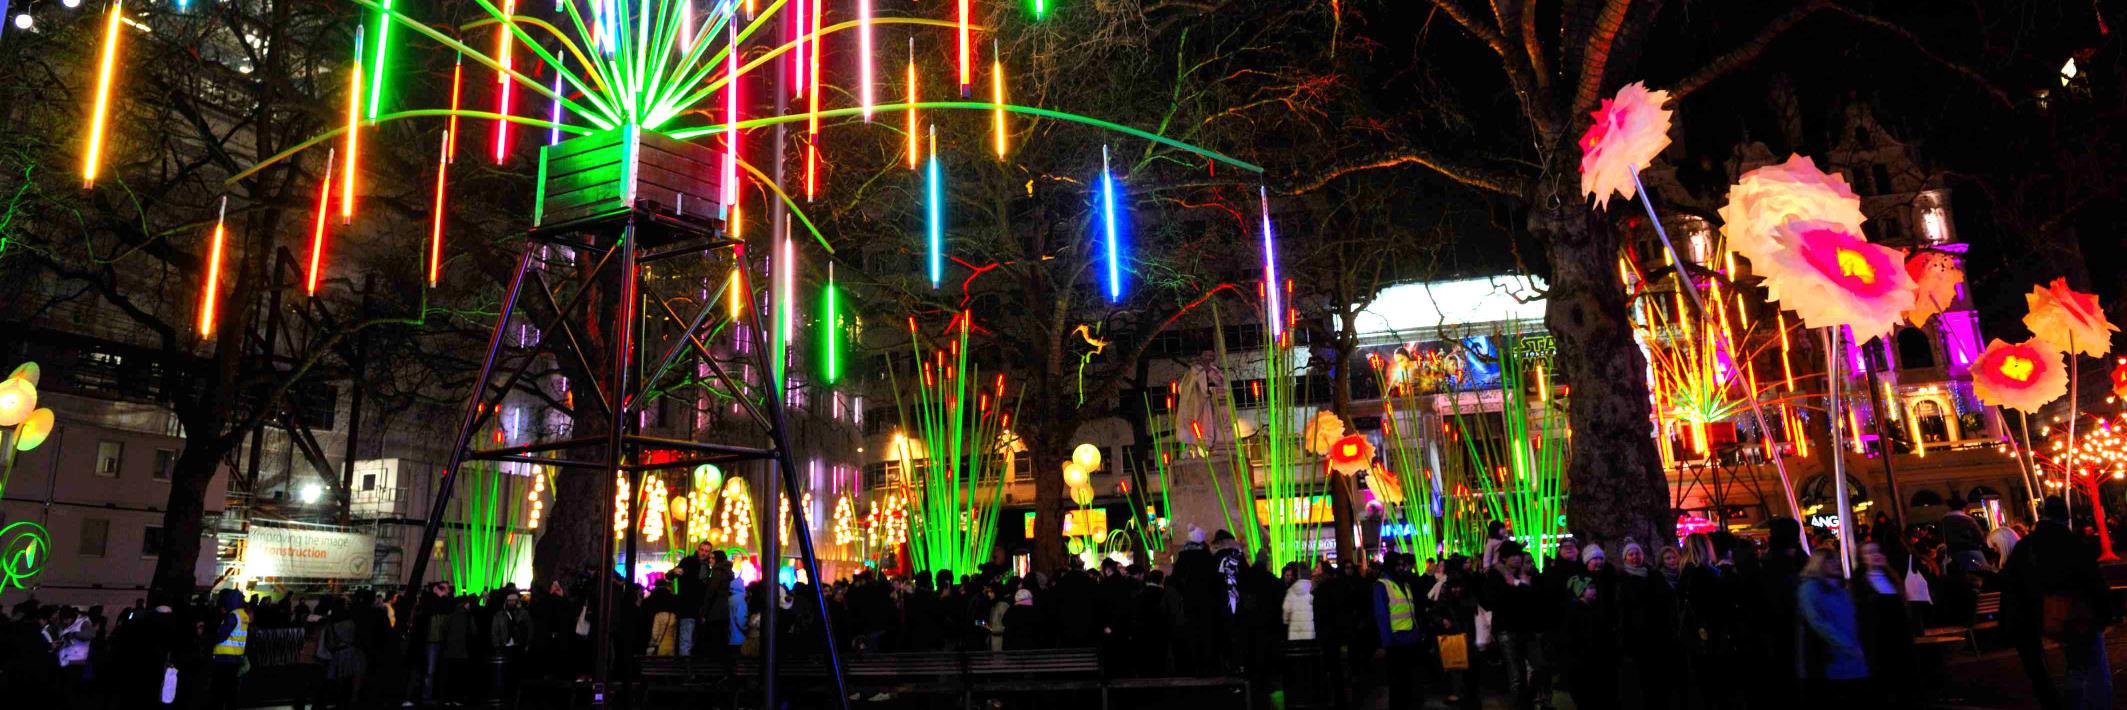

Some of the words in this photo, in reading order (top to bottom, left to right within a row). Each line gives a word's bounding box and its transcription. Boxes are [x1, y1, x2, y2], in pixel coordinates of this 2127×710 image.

[1513, 335, 1556, 352] STA
[1811, 514, 1840, 528] ANG
[251, 528, 301, 547] Improving
[304, 534, 319, 546] the
[321, 535, 348, 550] image
